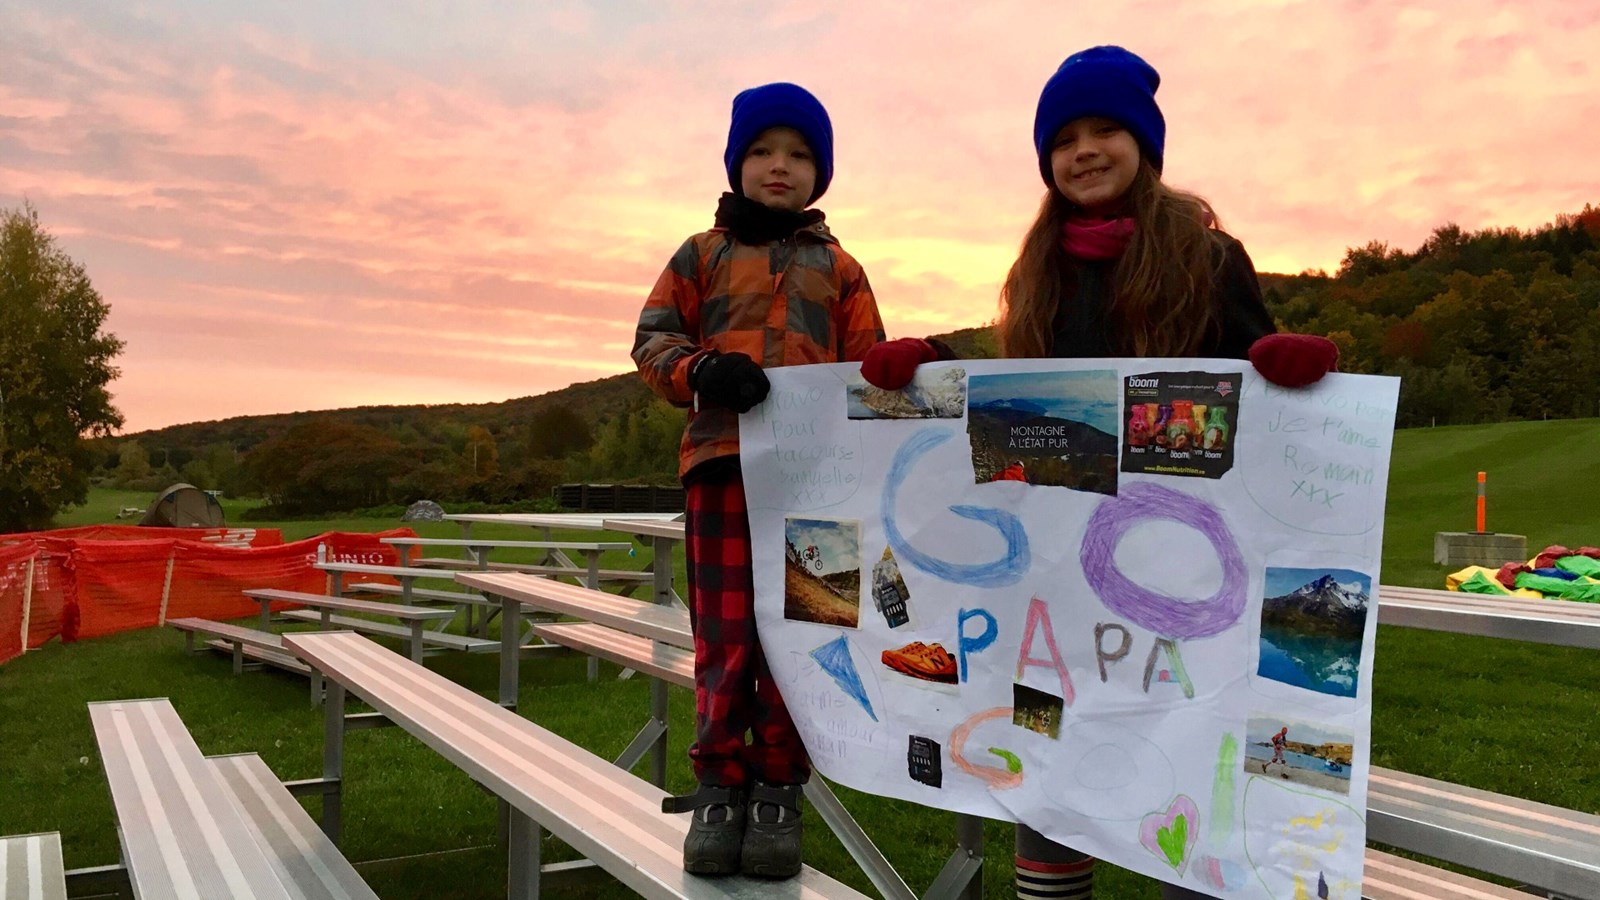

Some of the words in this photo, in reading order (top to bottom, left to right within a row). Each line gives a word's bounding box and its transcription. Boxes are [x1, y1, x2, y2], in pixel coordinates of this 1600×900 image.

[1010, 425, 1066, 436] MONTAGNE
[1009, 437, 1017, 448] À
[1018, 437, 1046, 449] L'ÉTAT
[1048, 438, 1069, 449] PUR
[305, 552, 384, 566] SUNTO
[957, 593, 1195, 708] PAPA
